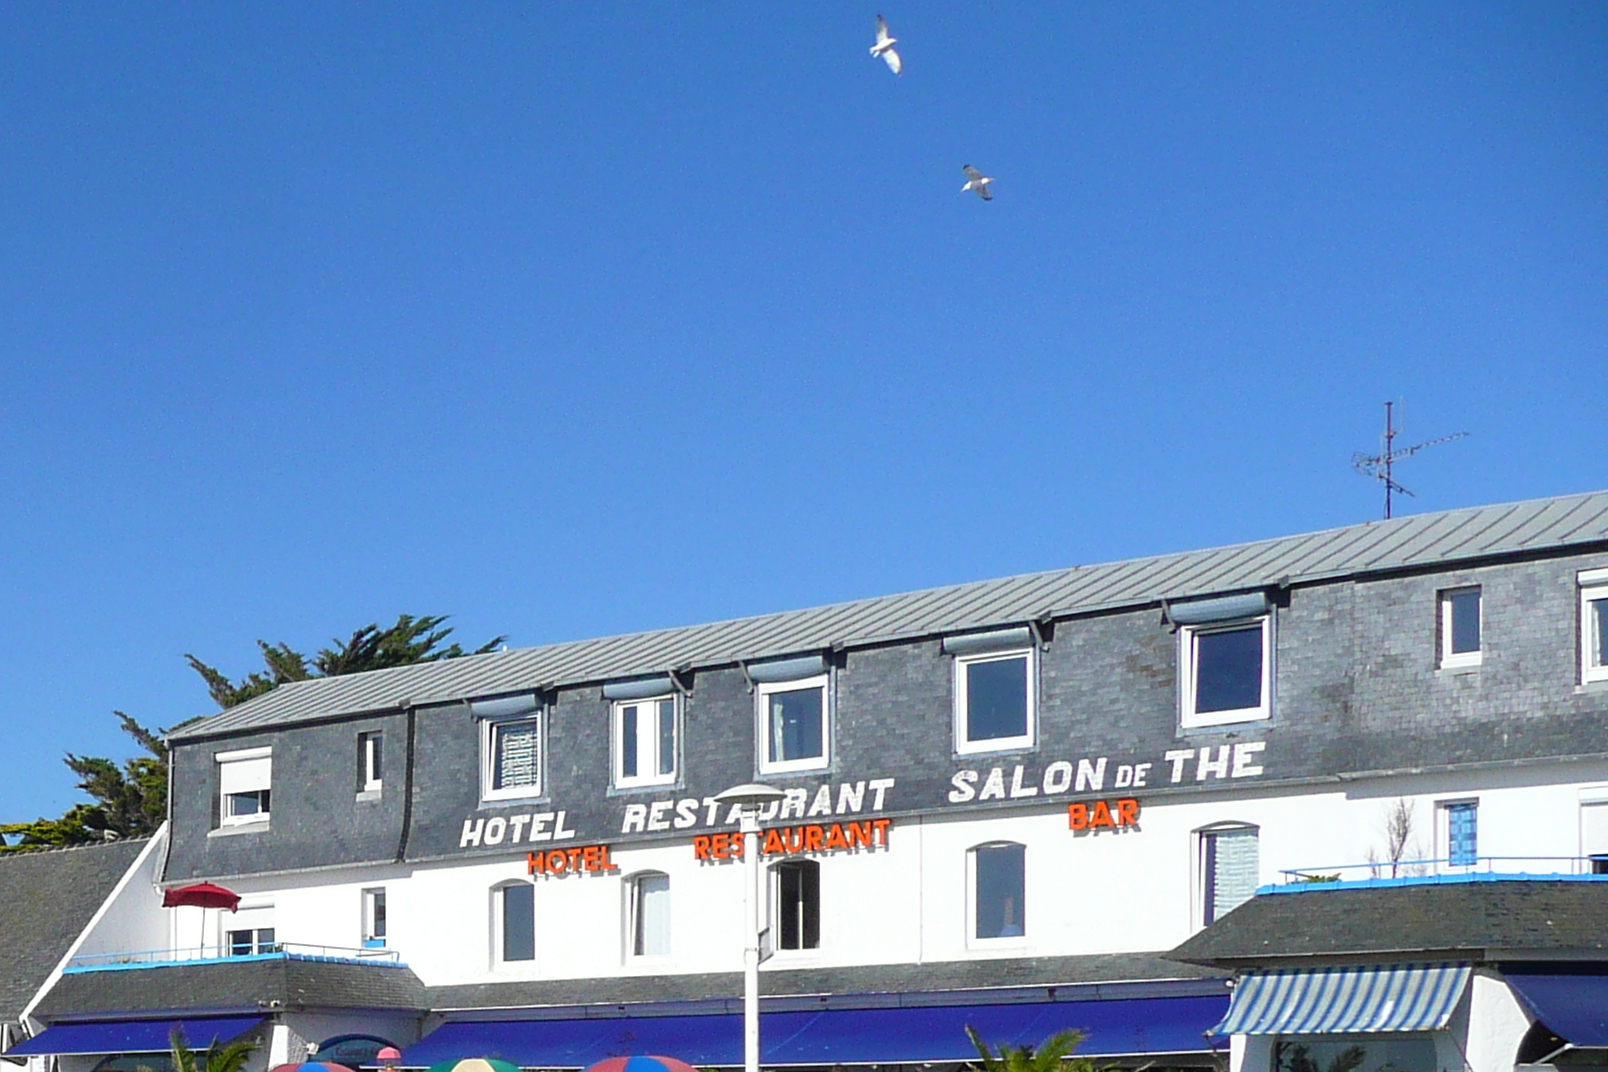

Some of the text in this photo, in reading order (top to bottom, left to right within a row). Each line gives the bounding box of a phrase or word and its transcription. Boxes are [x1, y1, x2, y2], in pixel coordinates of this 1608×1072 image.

[459, 810, 576, 848] HOTEL
[948, 757, 1107, 803] SALON
[1114, 763, 1152, 788] DE
[1164, 741, 1267, 783] THE
[1068, 799, 1139, 831] BAR
[693, 819, 891, 860] RESAURANT
[527, 845, 619, 875] HOTEL
